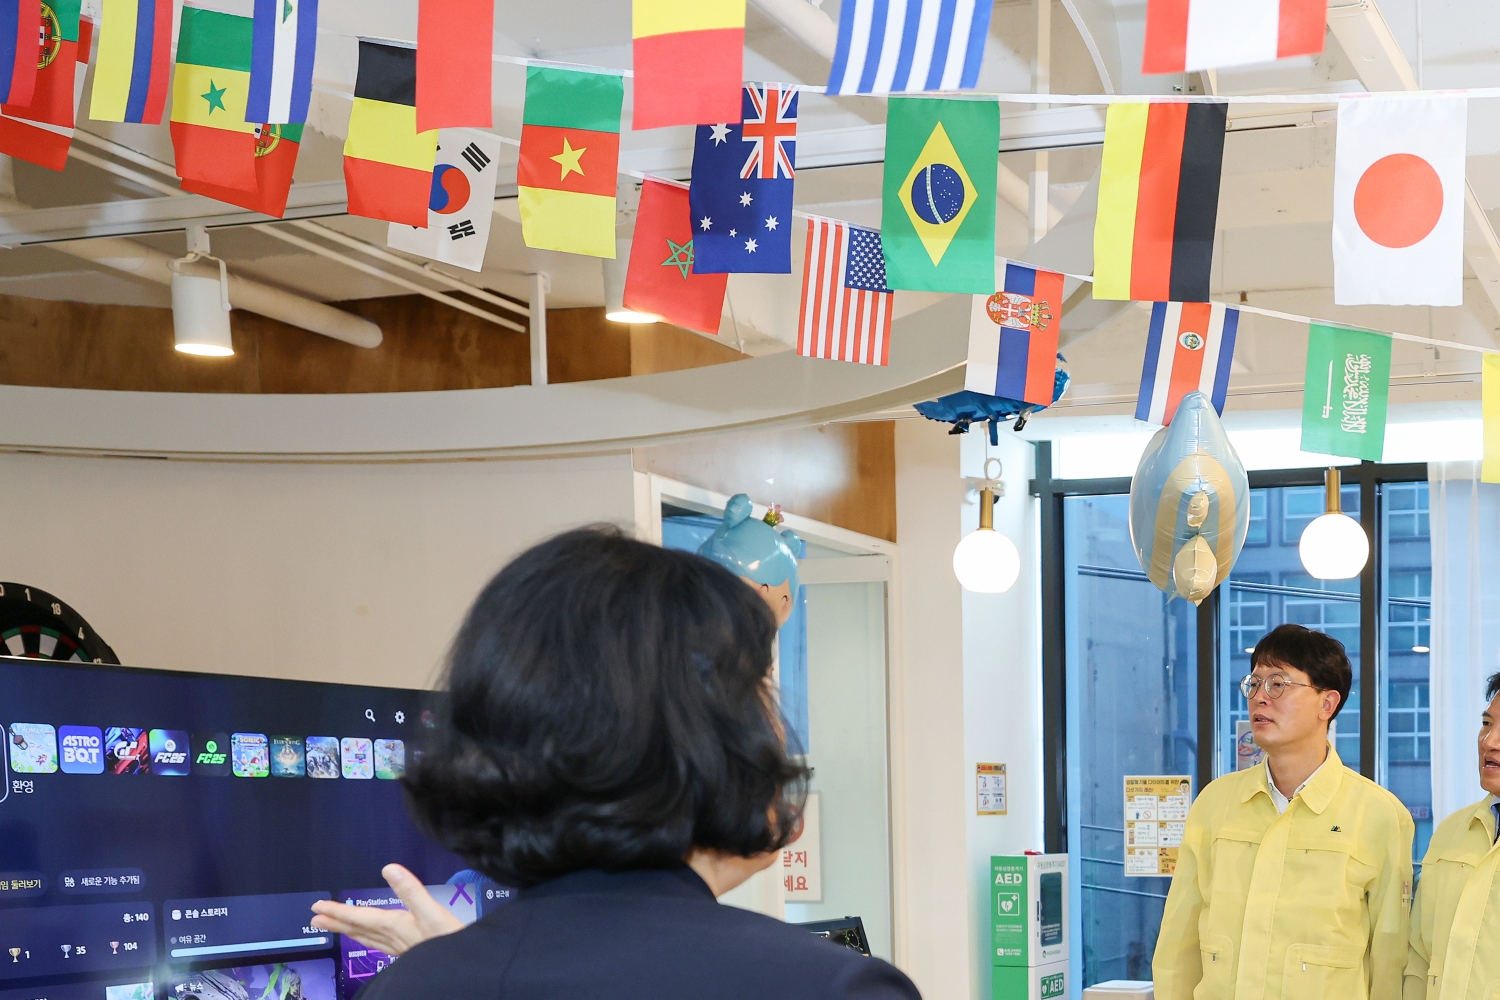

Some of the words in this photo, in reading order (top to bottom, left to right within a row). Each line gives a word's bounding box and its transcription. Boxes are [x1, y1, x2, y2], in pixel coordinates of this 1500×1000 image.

[25, 588, 31, 601] 1
[51, 603, 62, 615] 18
[77, 627, 85, 640] 4
[63, 735, 100, 747] ASTRO
[64, 747, 100, 764] BOT
[154, 752, 187, 763] FC26
[196, 753, 227, 764] FC25
[12, 780, 34, 794] 환영
[80, 877, 102, 887] 새로운
[104, 876, 118, 885] 기능
[119, 875, 140, 885] 추가됨
[995, 873, 1023, 884] AED
[11, 879, 41, 890] 둘러보기
[356, 898, 388, 907] PlayStation
[135, 913, 149, 922] 140
[184, 909, 199, 919] 콘솔
[200, 907, 228, 917] 스토리지
[178, 935, 192, 944] 여유
[193, 934, 207, 943] 공간
[75, 946, 87, 955] 35
[123, 942, 138, 951] 104
[24, 950, 30, 959] 1
[189, 982, 204, 991] 뉴스
[1049, 978, 1064, 994] AED
